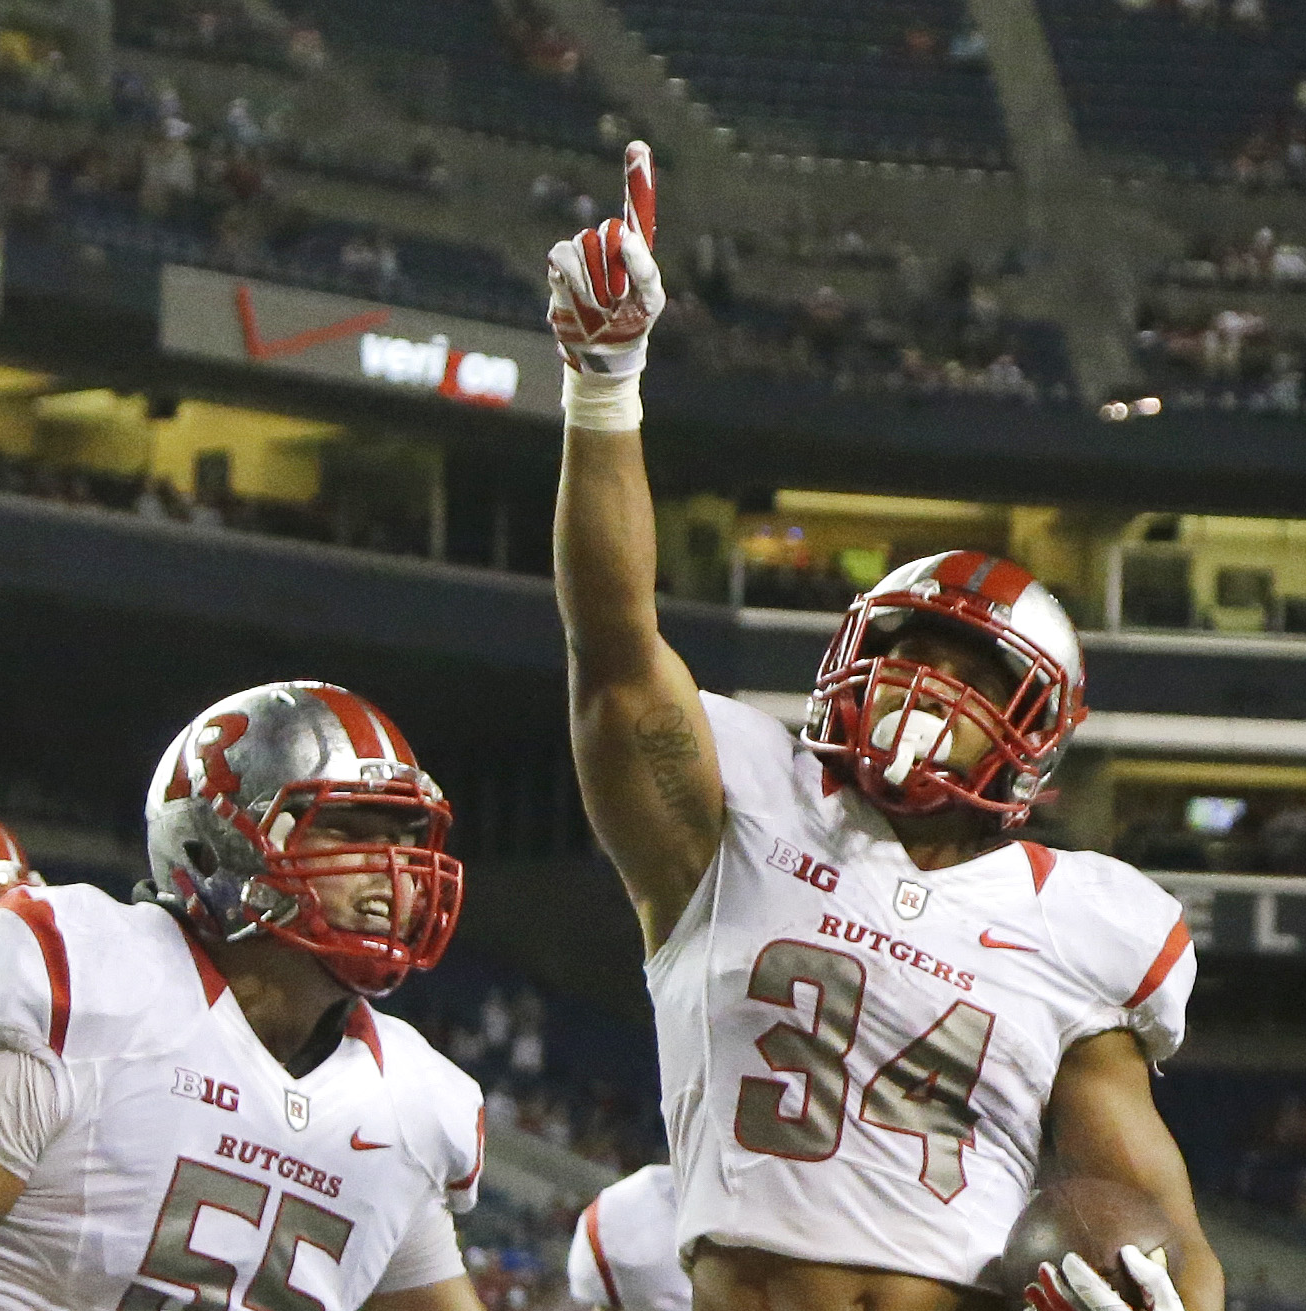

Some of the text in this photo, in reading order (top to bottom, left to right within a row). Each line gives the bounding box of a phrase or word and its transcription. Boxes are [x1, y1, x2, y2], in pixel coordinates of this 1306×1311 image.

[818, 912, 975, 992] RUTGERS
[734, 938, 997, 1204] 34
[215, 1133, 343, 1198] RUTGERS
